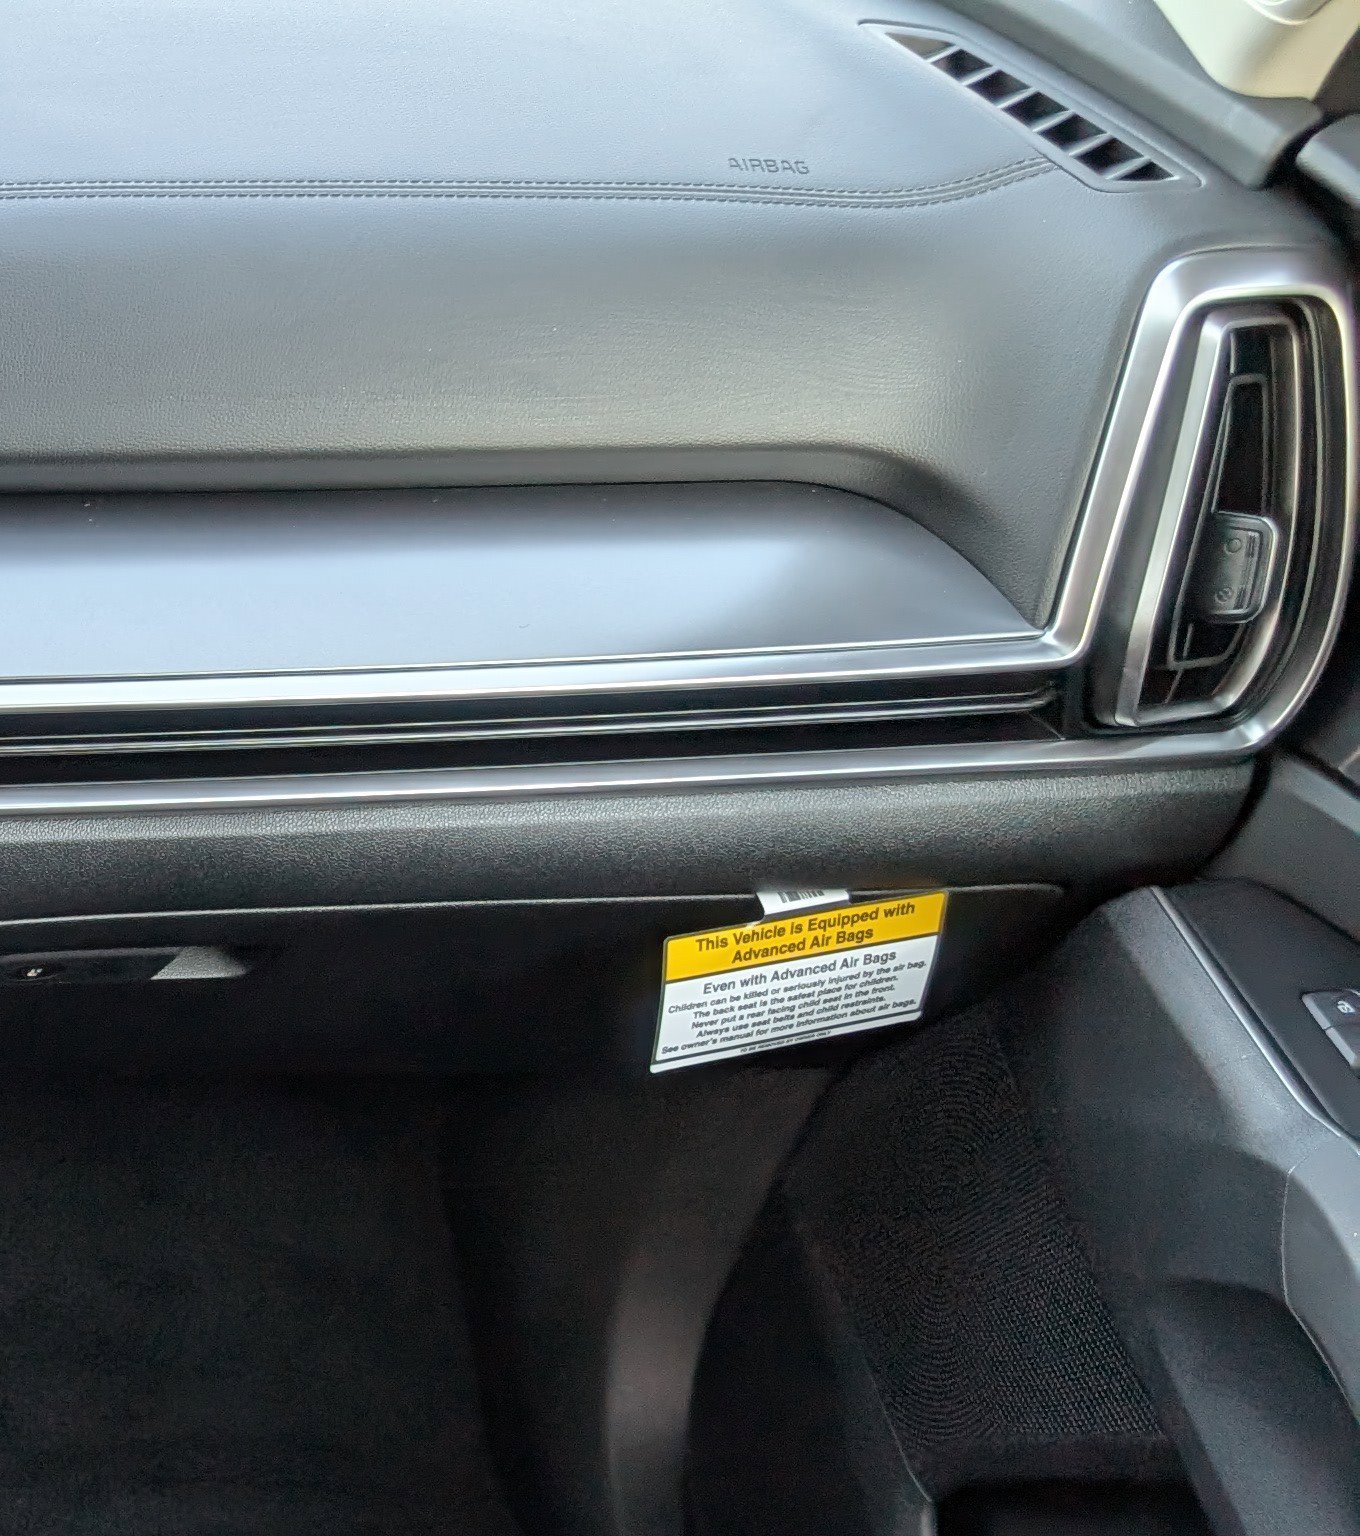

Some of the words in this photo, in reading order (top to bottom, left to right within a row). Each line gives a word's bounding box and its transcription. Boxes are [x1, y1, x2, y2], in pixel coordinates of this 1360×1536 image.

[728, 157, 810, 175] AIRBAG
[696, 935, 728, 952] This
[733, 925, 786, 945] Vehicle
[790, 922, 802, 935] is
[808, 907, 879, 932] Equipped
[883, 902, 916, 918] with
[732, 937, 806, 964] Advanced
[809, 933, 832, 949] Air
[836, 928, 874, 943] Bags
[668, 1001, 708, 1014] Children
[710, 997, 727, 1006] can
[730, 994, 741, 1002] be
[743, 989, 769, 1000] killed
[771, 987, 781, 995] or
[783, 979, 826, 993] seriously
[827, 971, 861, 985] injured
[863, 970, 874, 978] by
[876, 967, 891, 975] the
[893, 963, 905, 972] air
[907, 960, 926, 970] bag.
[703, 980, 736, 995] Even
[740, 973, 767, 988] with
[770, 960, 837, 982] Advanced
[839, 956, 859, 970] Air
[863, 951, 897, 966] Bags
[691, 1019, 719, 1030] Never
[721, 1015, 737, 1026] put
[746, 1010, 766, 1020] rear
[768, 1004, 796, 1015] facing
[798, 998, 821, 1010] child
[823, 994, 843, 1004] seat
[855, 989, 869, 998] the
[693, 1011, 710, 1019] The
[712, 1006, 735, 1015] back
[738, 1001, 757, 1011] seat
[759, 999, 768, 1007] is
[770, 996, 785, 1005] the
[787, 990, 815, 1002] safest
[817, 986, 842, 998] place
[844, 983, 858, 991] for
[696, 1027, 730, 1039] Always
[732, 1023, 749, 1032] use
[751, 1018, 771, 1028] seat
[772, 1013, 795, 1024] belts
[797, 1008, 815, 1019] and
[816, 1004, 840, 1015] child
[661, 1045, 679, 1055] See
[681, 1037, 718, 1051] owner's
[719, 1030, 754, 1043] manual
[755, 1028, 769, 1037] for
[770, 1023, 794, 1034] more
[796, 1012, 848, 1028] information
[850, 1006, 877, 1017] about
[878, 1003, 891, 1011] air
